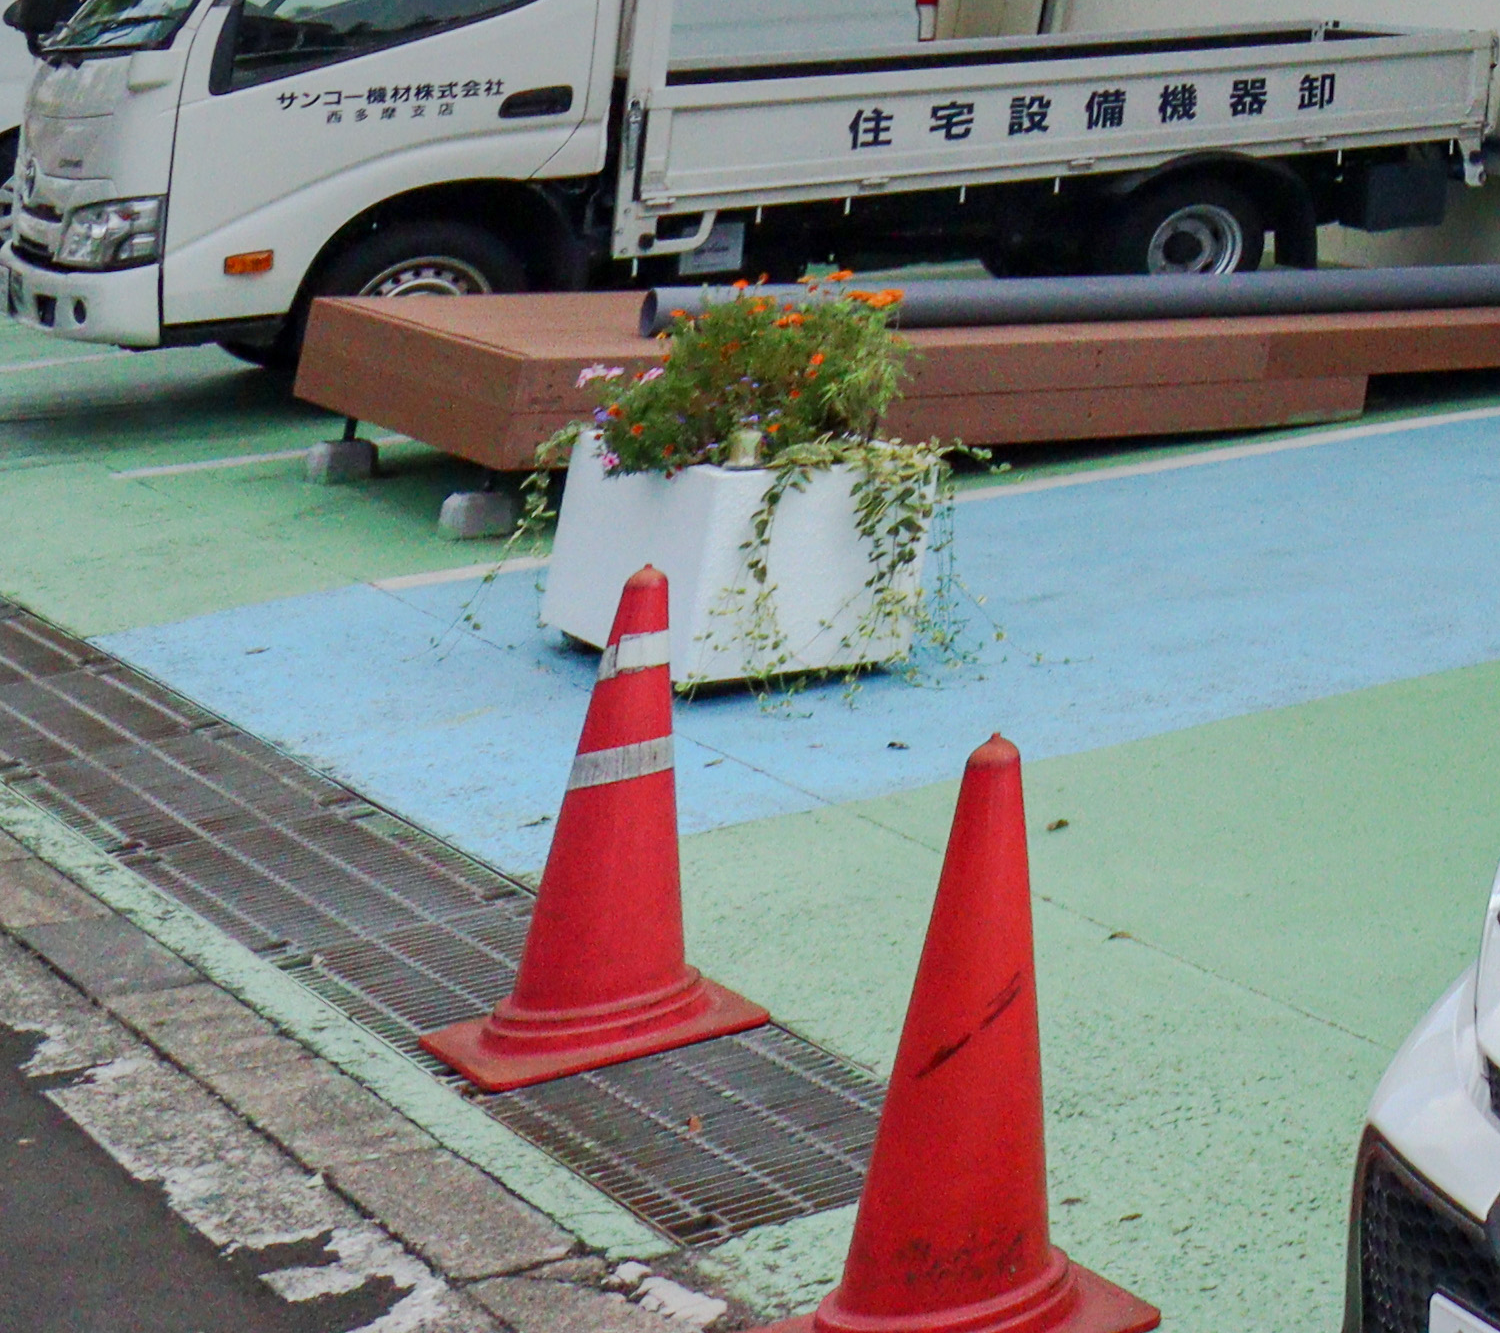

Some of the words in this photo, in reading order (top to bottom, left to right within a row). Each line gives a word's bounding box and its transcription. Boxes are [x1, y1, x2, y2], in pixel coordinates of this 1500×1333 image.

[276, 79, 504, 111] サンコー機材株式会社
[326, 101, 456, 124] 西多摩支店
[848, 73, 1337, 151] 住宅設備機器卸
